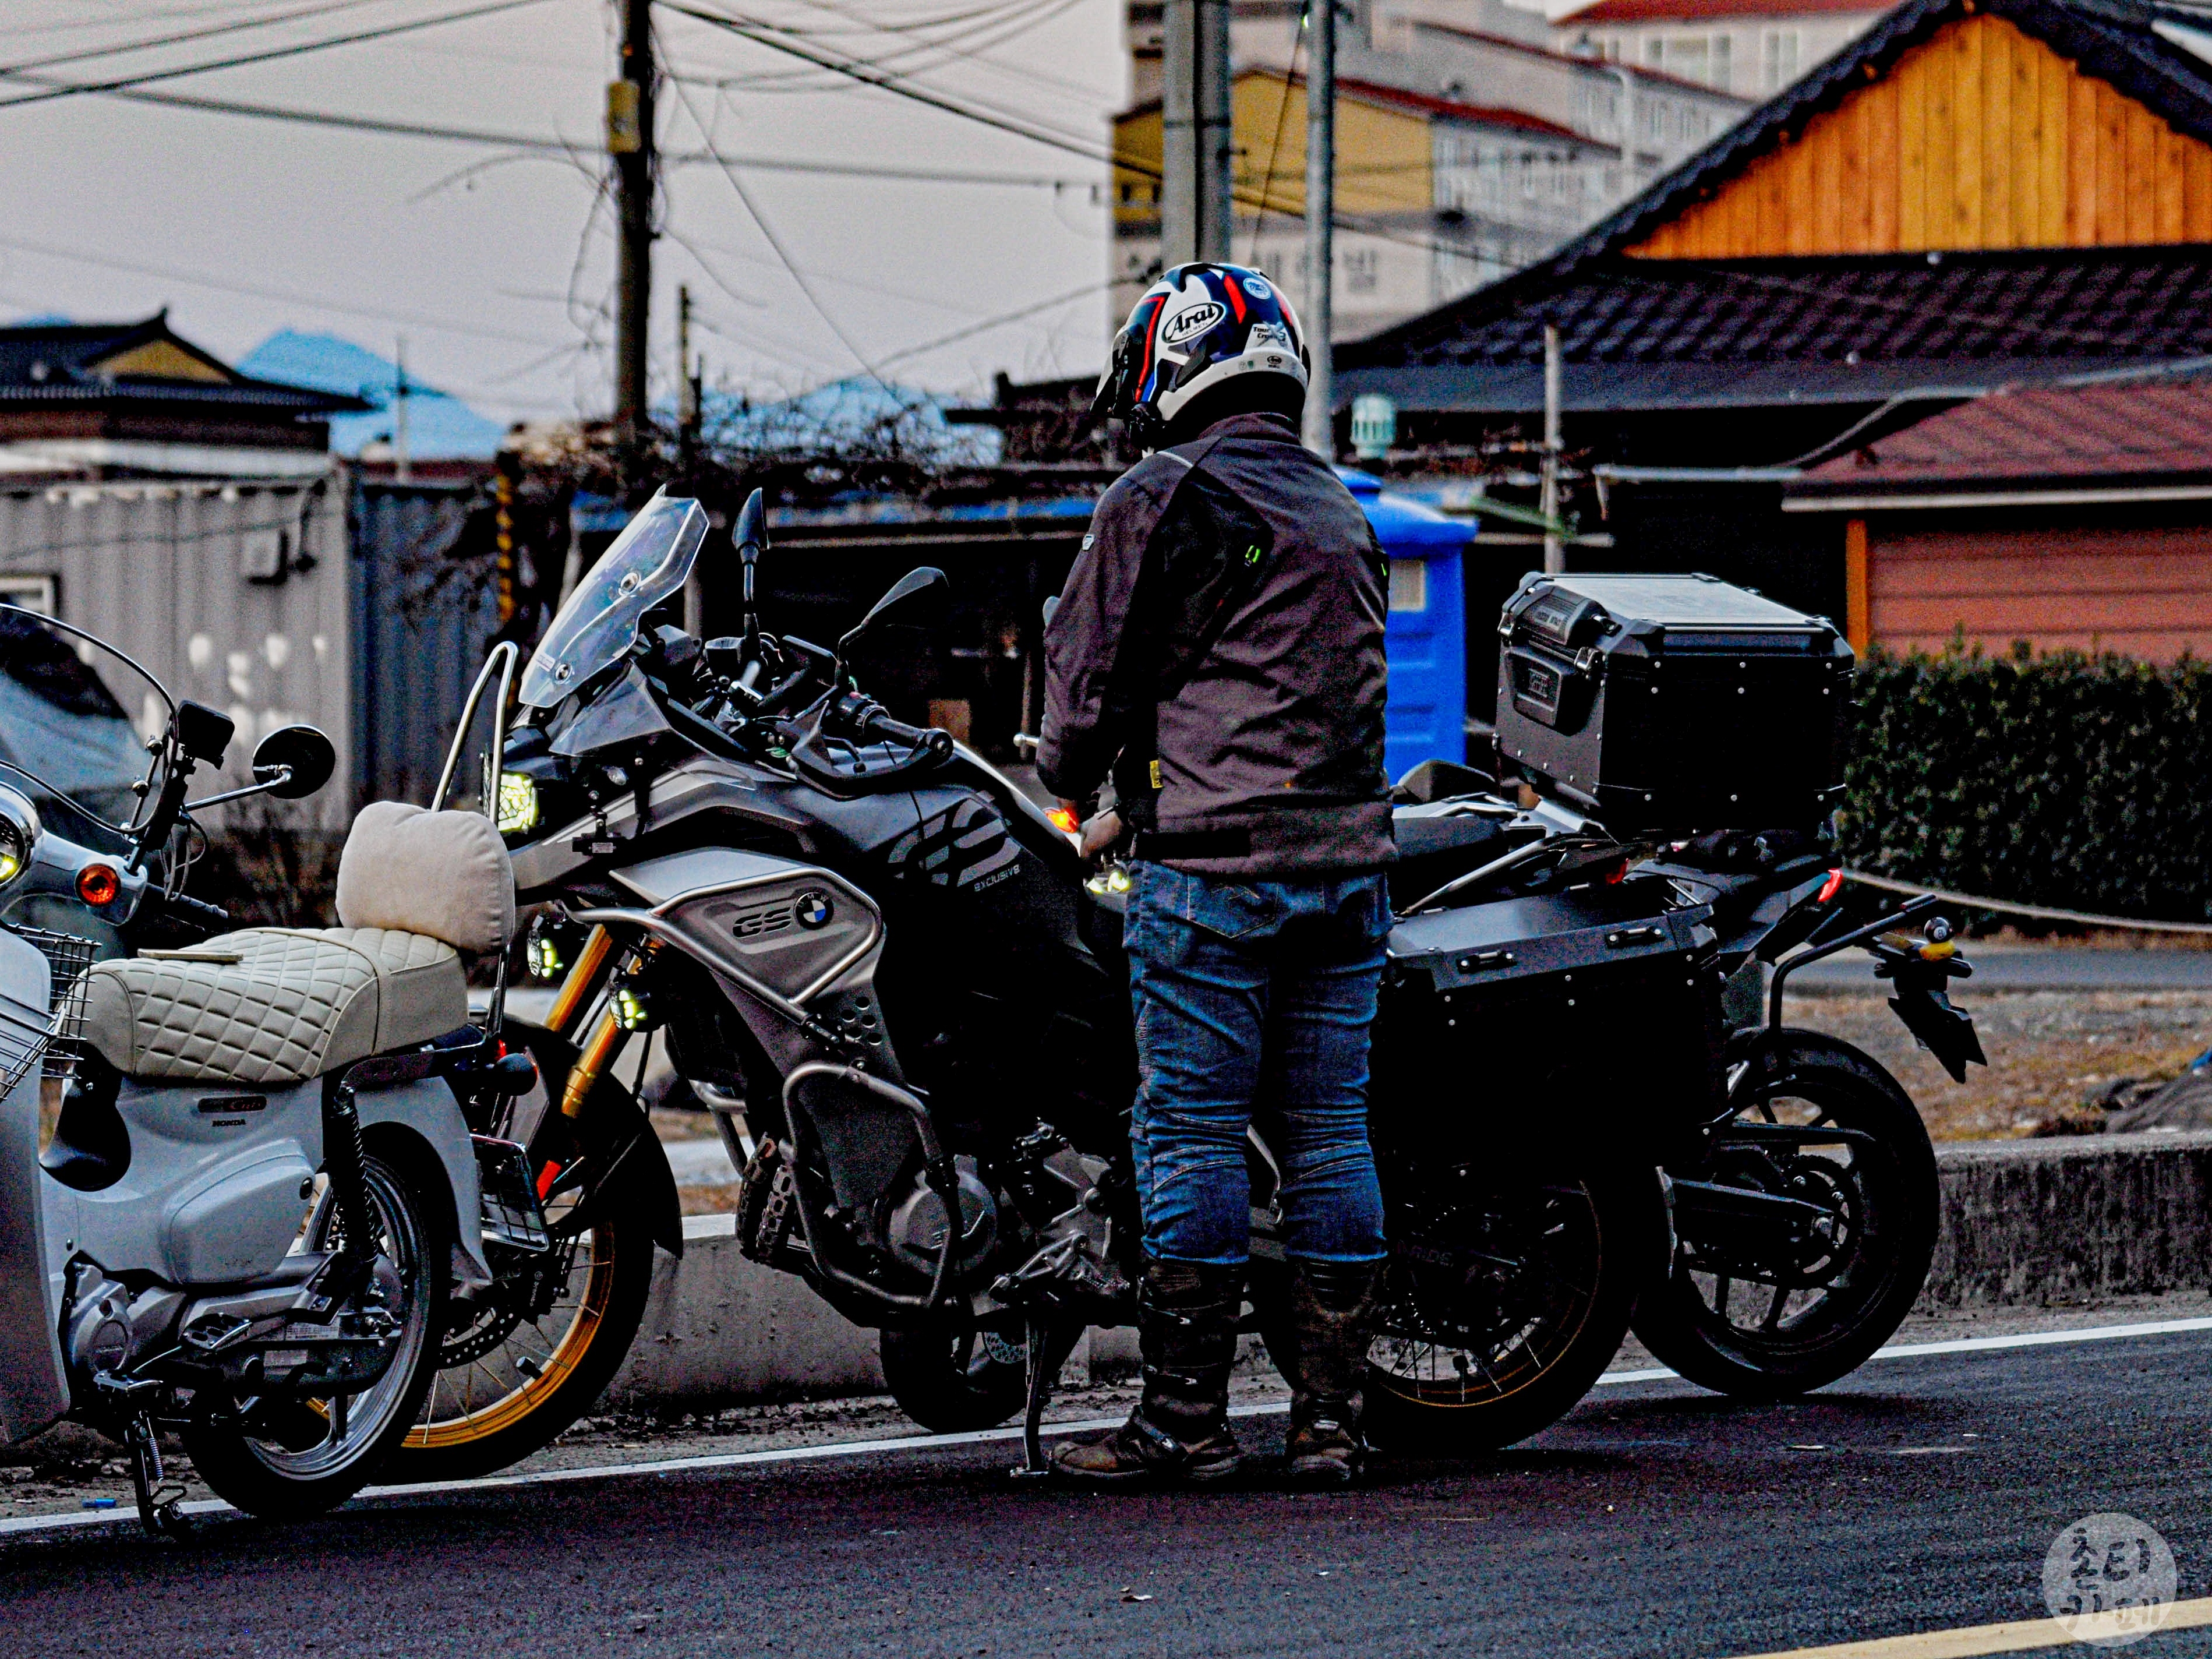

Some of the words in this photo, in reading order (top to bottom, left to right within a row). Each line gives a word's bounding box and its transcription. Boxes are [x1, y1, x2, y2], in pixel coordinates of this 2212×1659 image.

[1166, 302, 1215, 340] Arai
[733, 906, 792, 938] GS
[212, 1118, 246, 1127] HONDA
